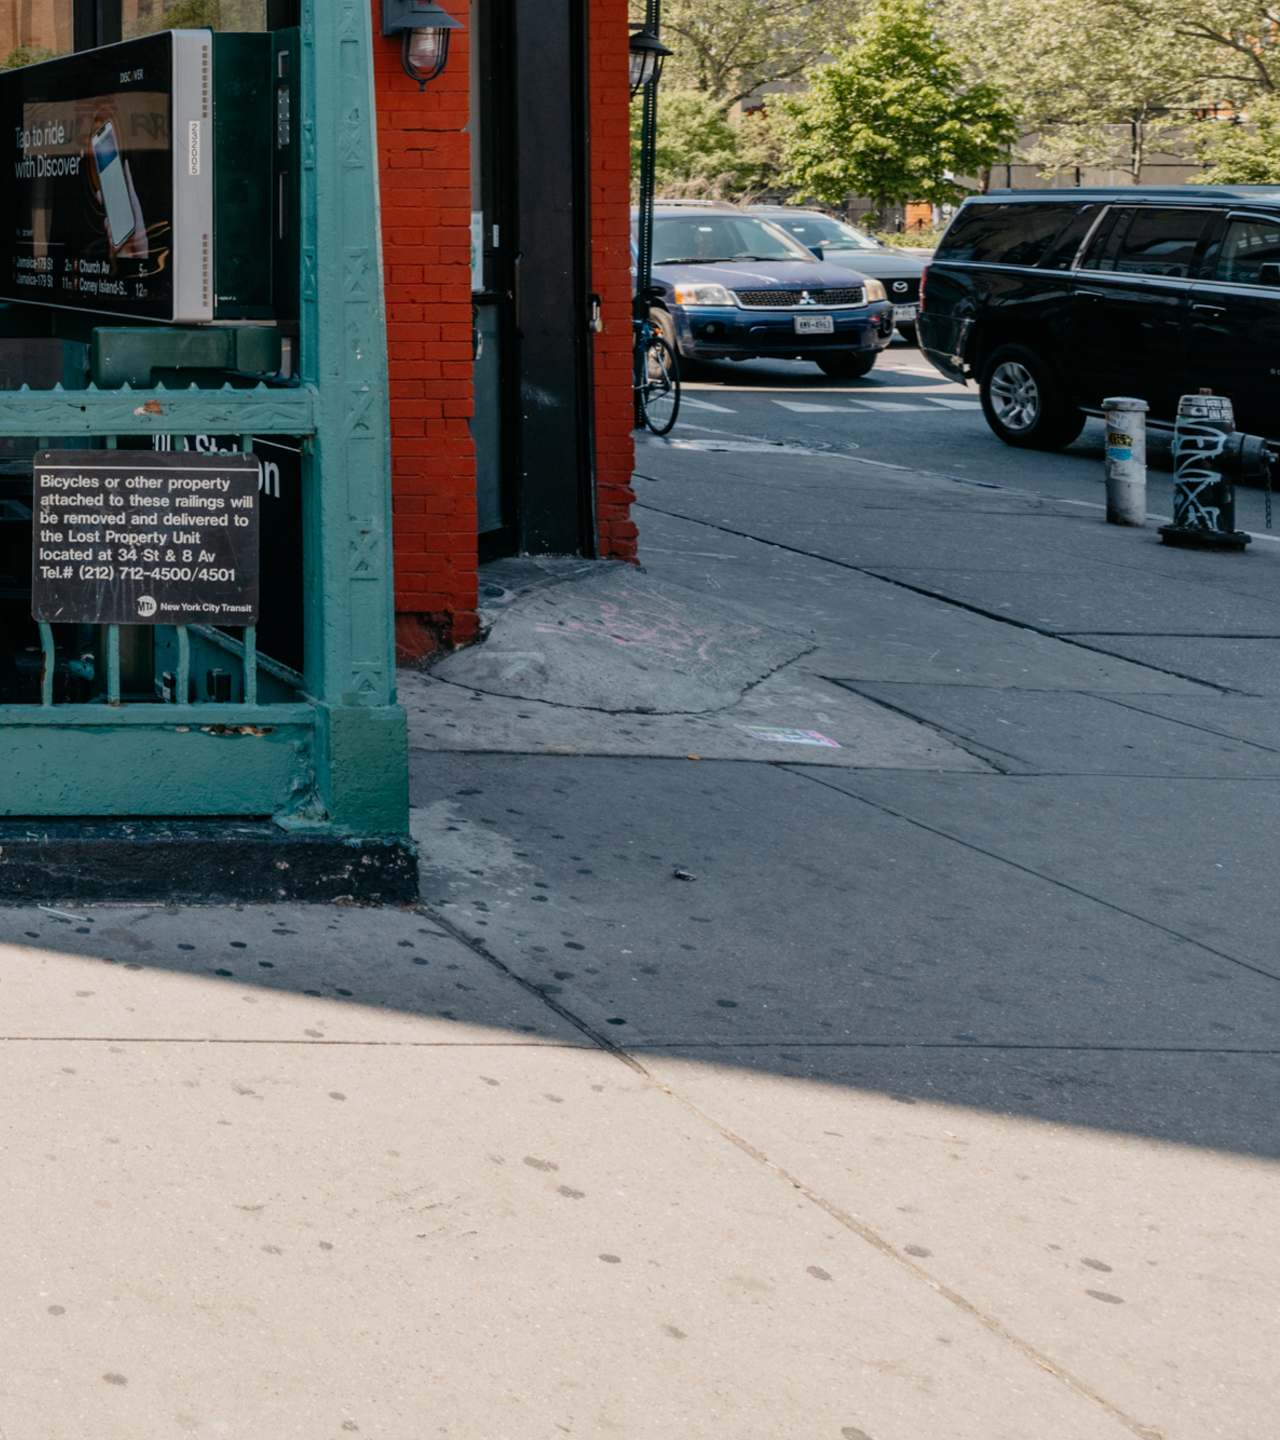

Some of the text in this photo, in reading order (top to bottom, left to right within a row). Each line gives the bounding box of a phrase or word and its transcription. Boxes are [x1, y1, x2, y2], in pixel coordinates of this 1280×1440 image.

[120, 69, 144, 83] DISCVER
[15, 120, 64, 155] Tap to ride
[15, 154, 35, 178] with
[80, 259, 100, 273] Church
[79, 278, 97, 295] Coney
[40, 475, 230, 493] Bicycles or other property
[40, 494, 253, 509] attached to these railings will
[40, 512, 249, 526] be removed and delivered to
[40, 531, 201, 546] the Lost Property Unit
[40, 548, 216, 562] located at 34 St & 8 Av
[40, 566, 235, 581] Tel.# (212) 712-4500/4501
[161, 603, 180, 612] New
[181, 603, 201, 612] York
[203, 604, 220, 613] City
[222, 604, 252, 612] Transit
